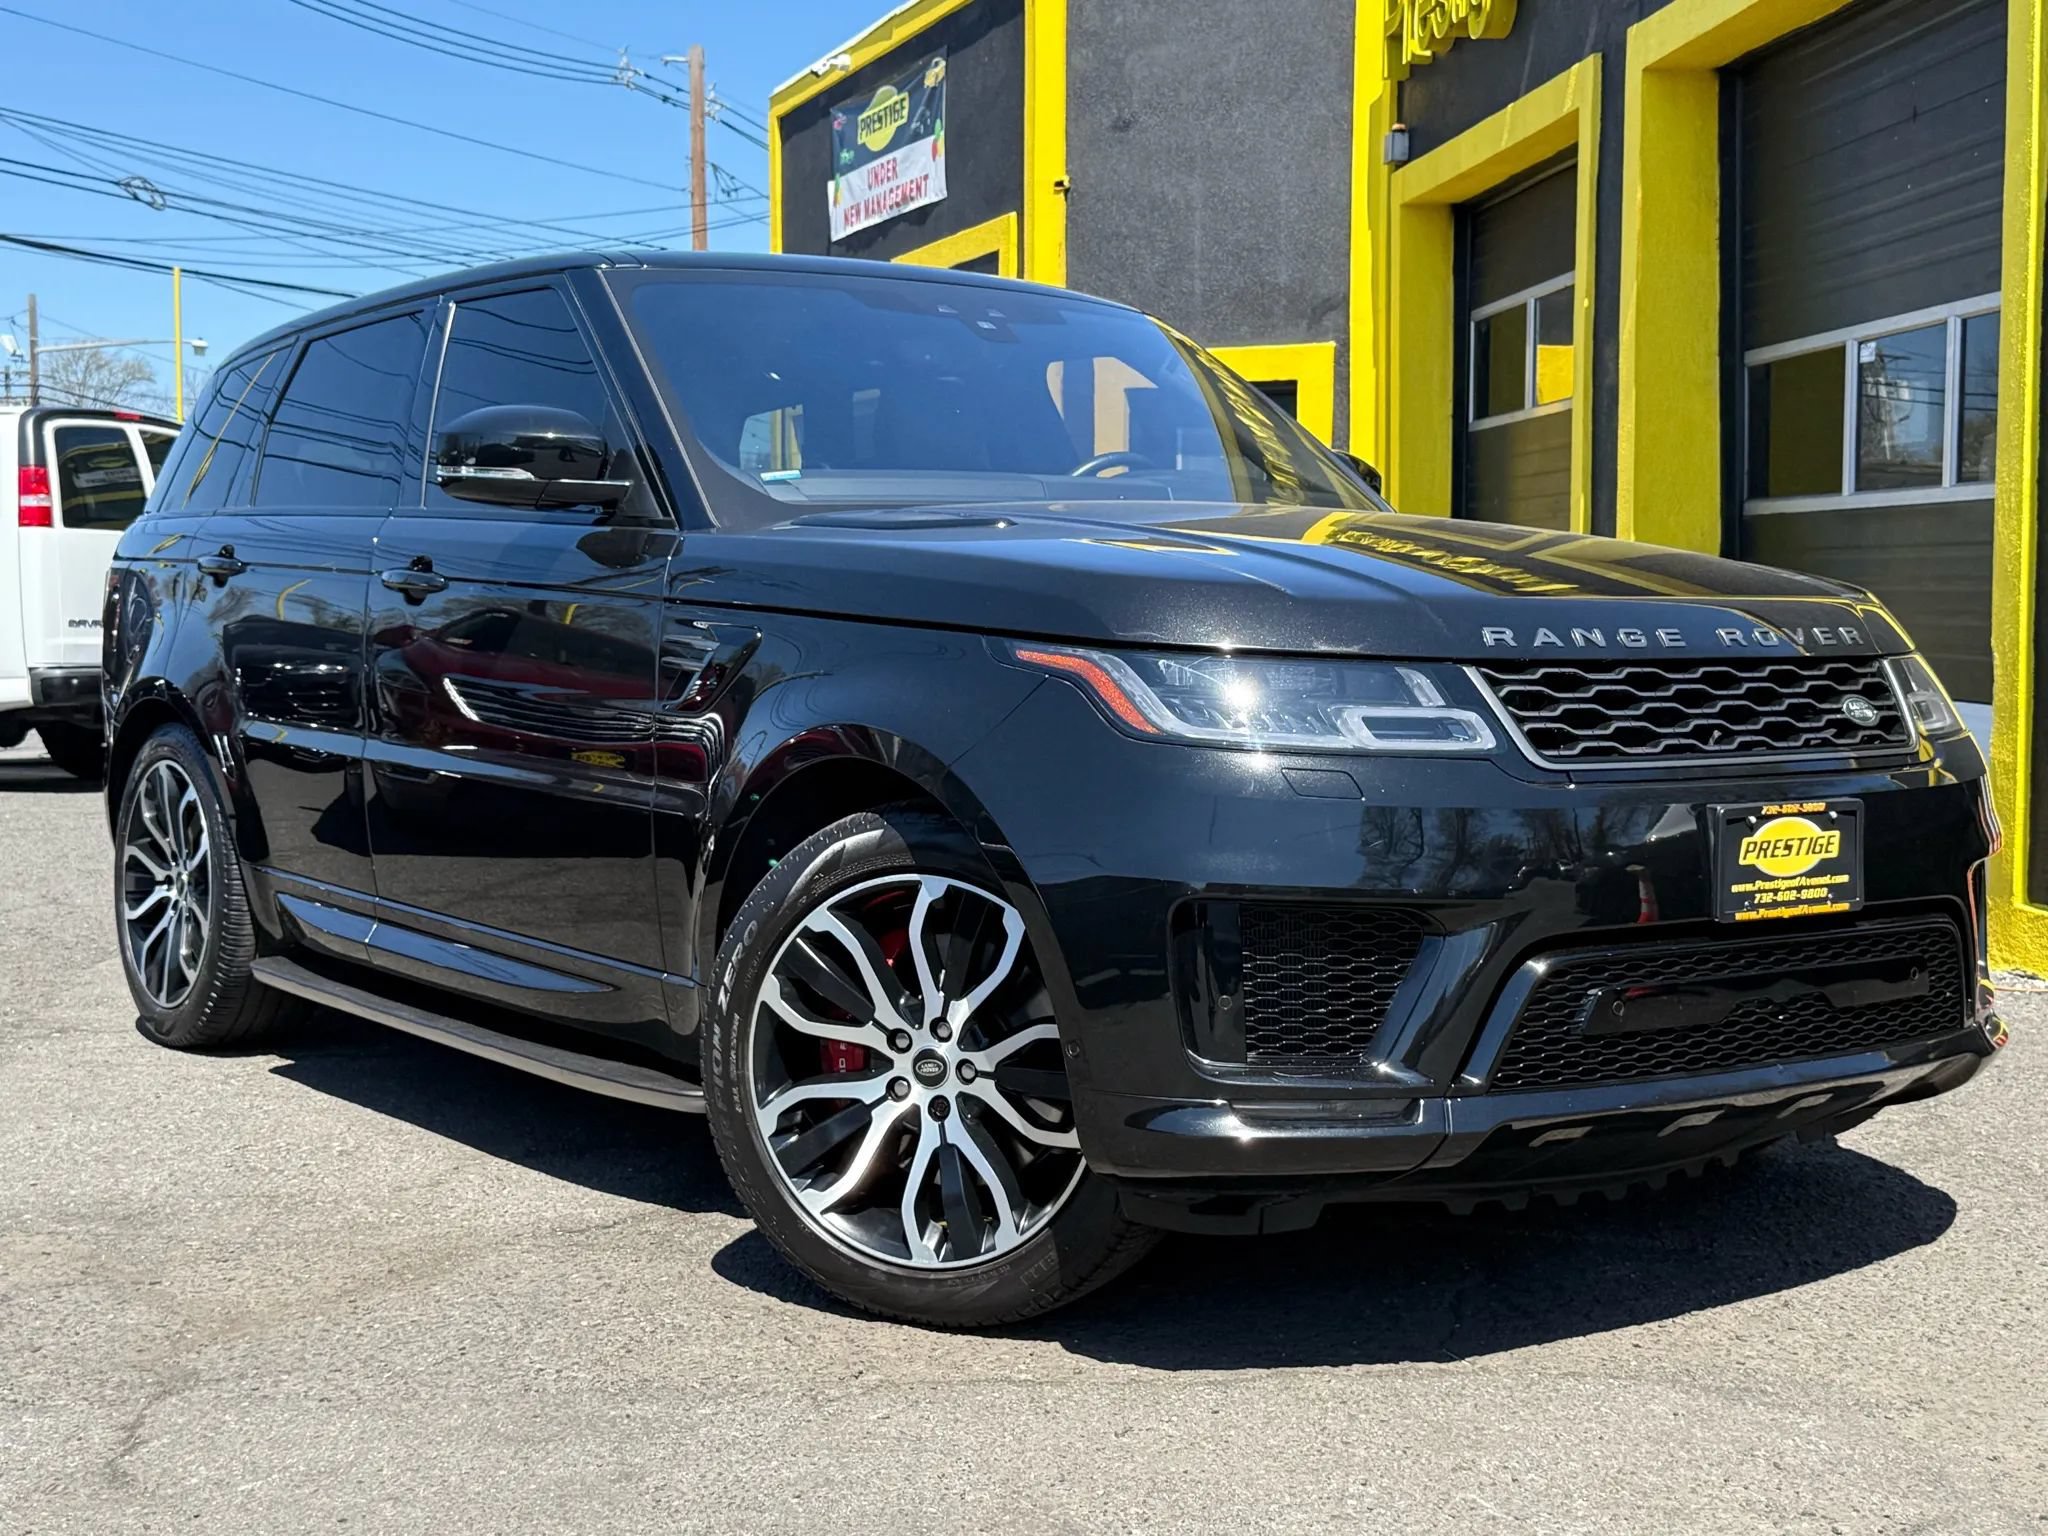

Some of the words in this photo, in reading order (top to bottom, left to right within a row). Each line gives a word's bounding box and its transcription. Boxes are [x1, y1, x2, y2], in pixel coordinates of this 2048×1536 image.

[860, 97, 907, 140] PRESTIGE
[867, 157, 898, 191] UNDER
[844, 205, 861, 230] NEW
[864, 174, 929, 219] MANAGEMENT
[1482, 626, 1687, 648] RANGE
[1715, 626, 1865, 646] ROVER
[1743, 834, 1837, 861] PRESTIGE
[1754, 887, 1828, 904] 732-602-9800
[717, 919, 758, 1017] ZERO
